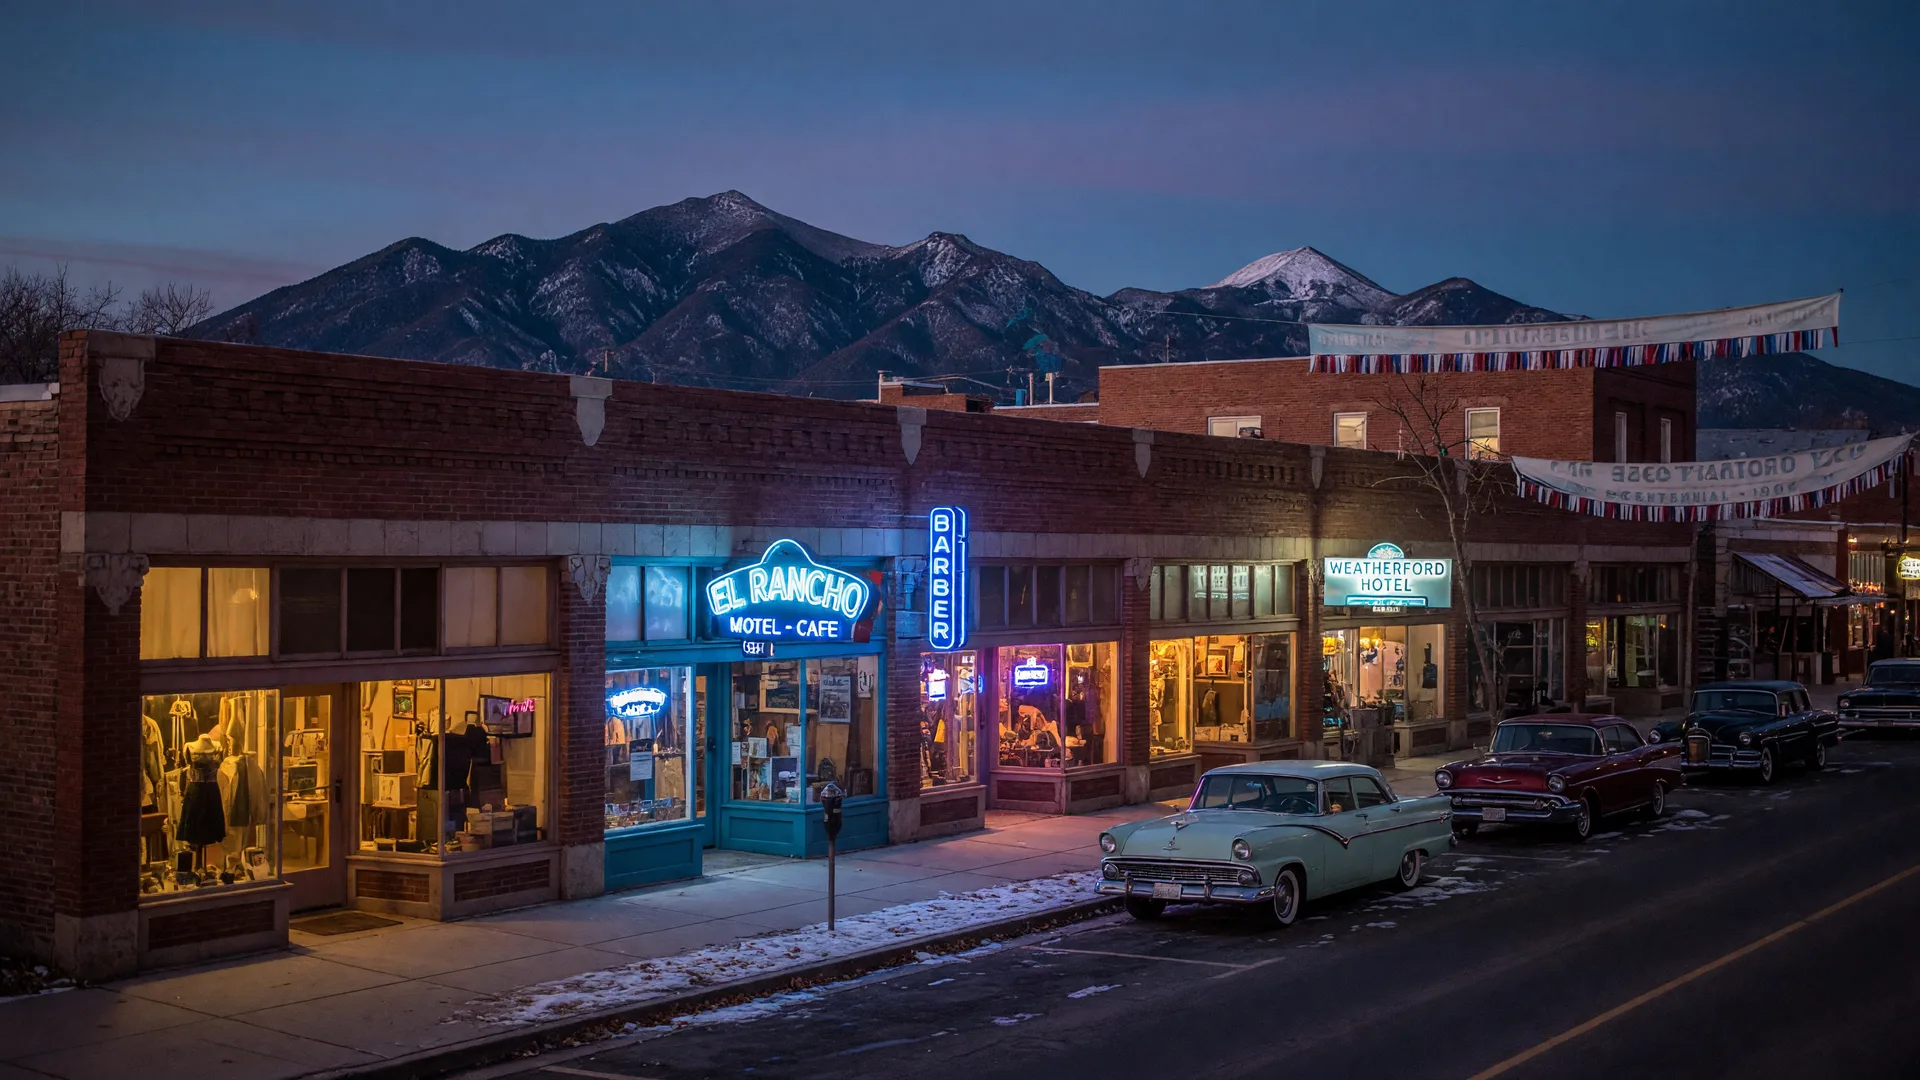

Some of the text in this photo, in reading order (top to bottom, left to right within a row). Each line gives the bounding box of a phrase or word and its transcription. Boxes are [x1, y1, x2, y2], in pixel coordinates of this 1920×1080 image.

[933, 514, 951, 639] BARBER
[1329, 561, 1445, 576] WEATHERFORD
[710, 566, 863, 618] EL RANCHO
[1361, 578, 1412, 592] HOTEL
[730, 616, 781, 635] MOTEL
[796, 619, 839, 637] CAFE
